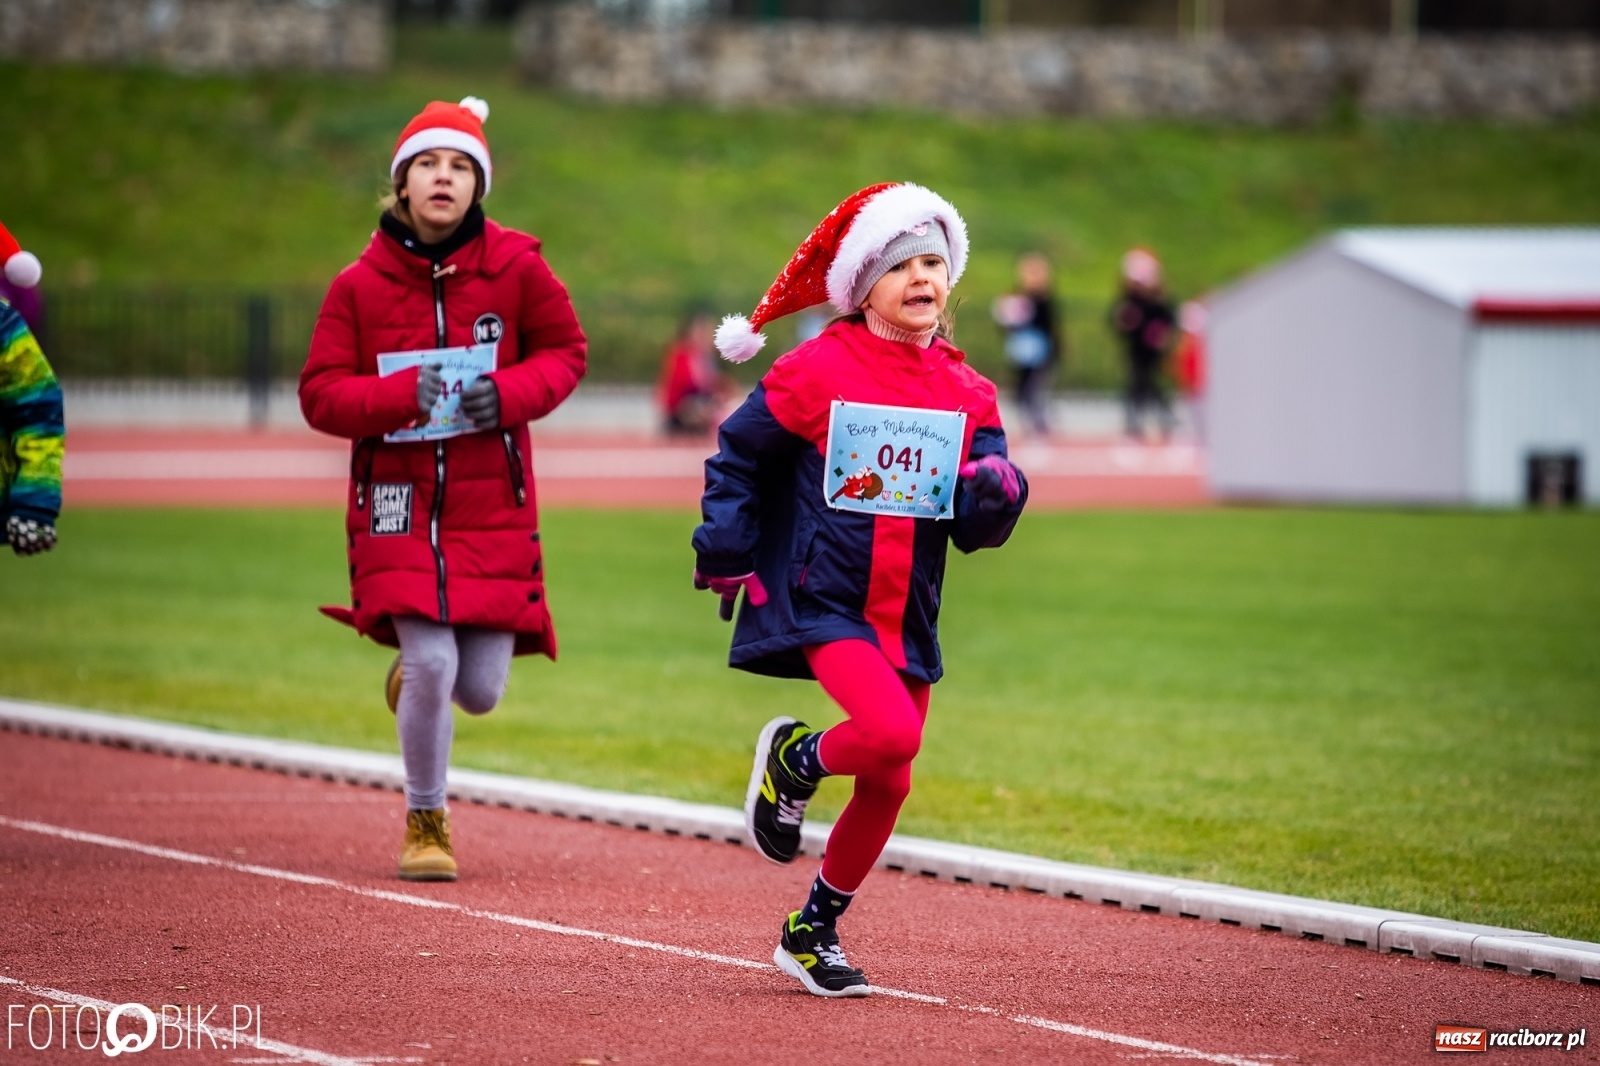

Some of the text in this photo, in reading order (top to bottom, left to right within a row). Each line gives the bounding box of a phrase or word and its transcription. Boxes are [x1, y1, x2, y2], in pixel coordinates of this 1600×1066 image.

[845, 422, 879, 437] Bieg
[877, 444, 923, 473] 041
[373, 484, 409, 501] APPLY
[373, 500, 408, 516] SOME
[375, 515, 405, 533] JUST
